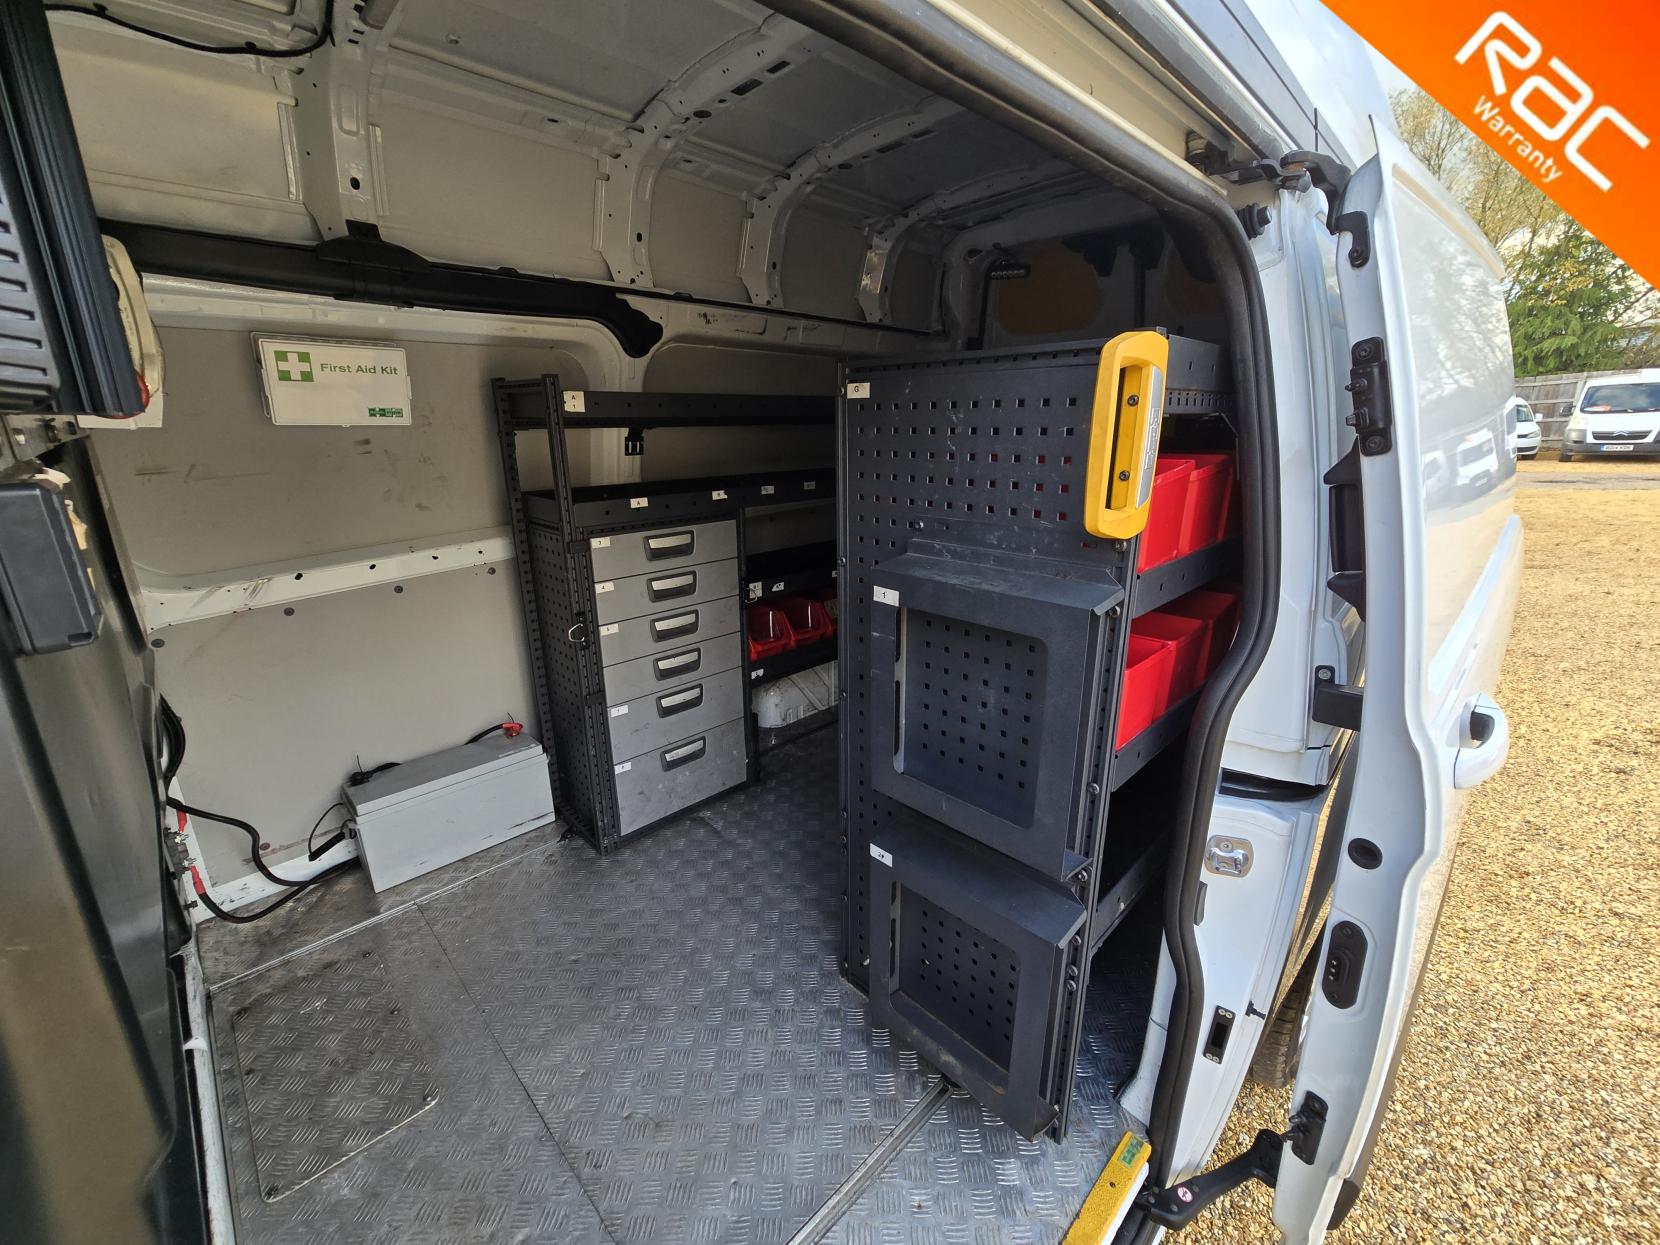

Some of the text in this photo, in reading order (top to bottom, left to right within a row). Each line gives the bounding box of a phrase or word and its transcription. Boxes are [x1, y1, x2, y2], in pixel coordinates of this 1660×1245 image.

[320, 362, 398, 376] First Aid Kit
